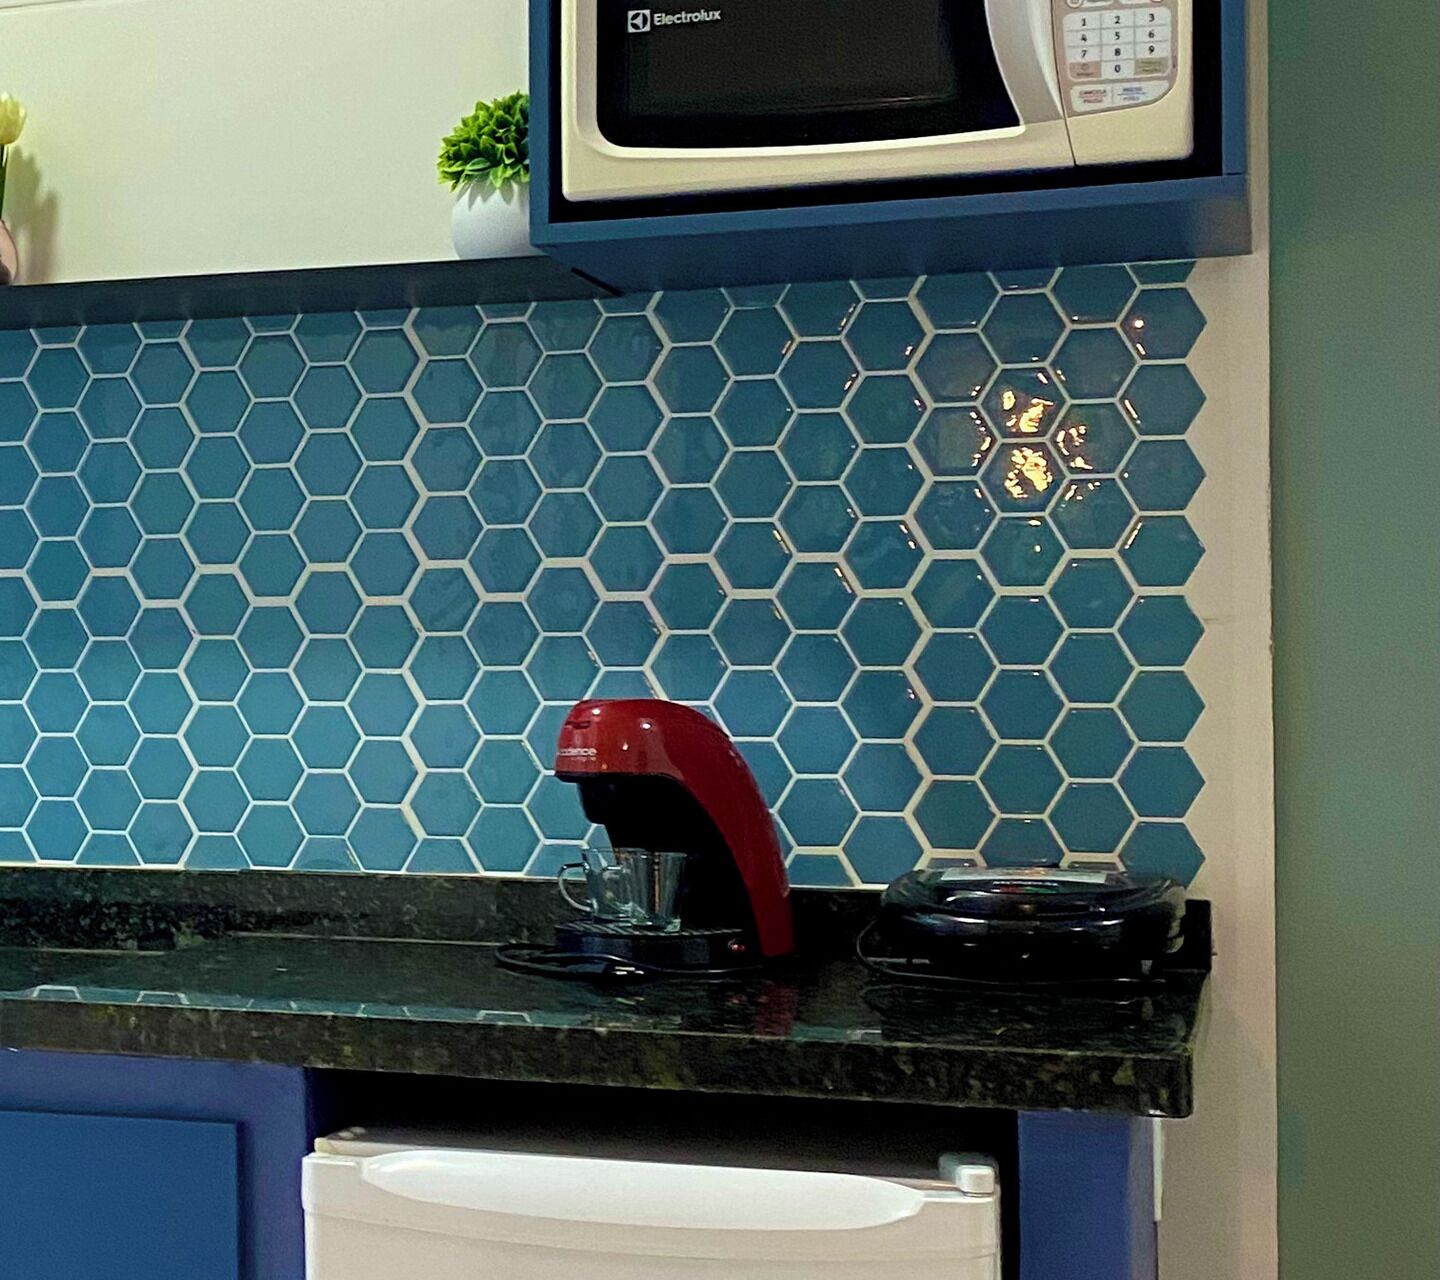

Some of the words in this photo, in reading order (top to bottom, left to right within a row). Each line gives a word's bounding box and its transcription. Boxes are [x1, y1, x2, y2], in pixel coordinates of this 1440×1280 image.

[654, 8, 721, 26] Electrolux
[1114, 15, 1121, 25] 2
[1148, 13, 1155, 22] 3
[1081, 17, 1087, 27] 1
[1080, 33, 1088, 42] 4
[1114, 31, 1121, 40] 5
[1148, 29, 1155, 38] 6
[1081, 49, 1088, 58] 7
[1114, 47, 1121, 57] 8
[1148, 45, 1155, 54] 9
[1114, 64, 1121, 73] 0
